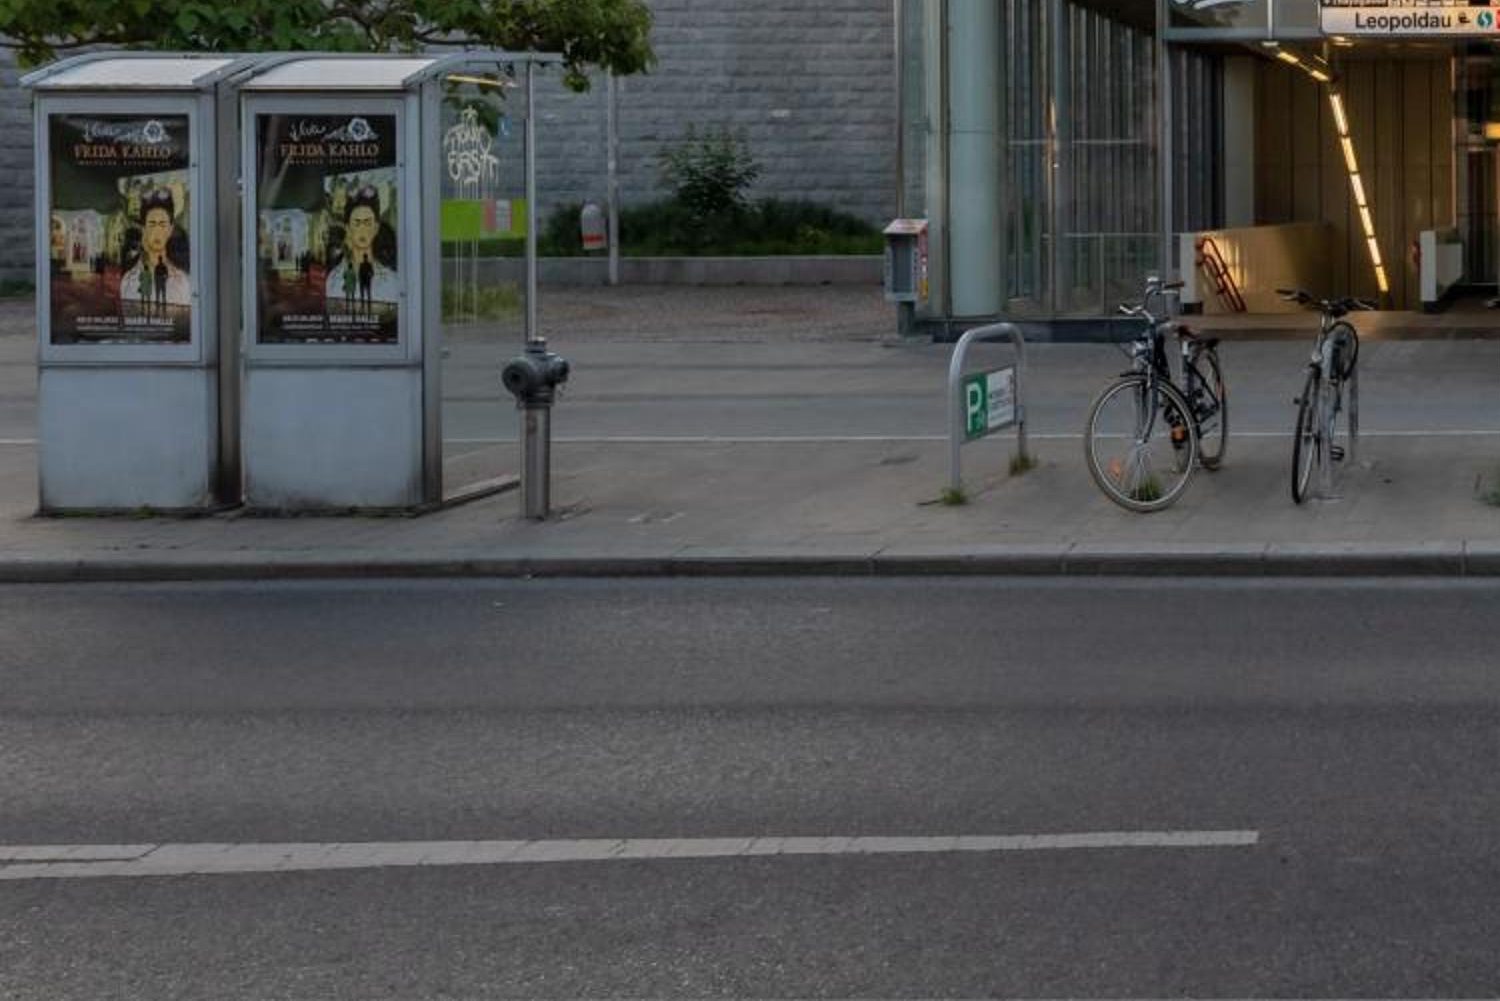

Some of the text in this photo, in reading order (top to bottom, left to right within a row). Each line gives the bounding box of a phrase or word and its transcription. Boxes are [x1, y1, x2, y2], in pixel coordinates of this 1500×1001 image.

[1355, 12, 1451, 32] Leopoldau
[73, 144, 172, 158] FRIDA KAHLO
[281, 143, 381, 157] FRIDA KAHLO
[966, 382, 983, 432] P
